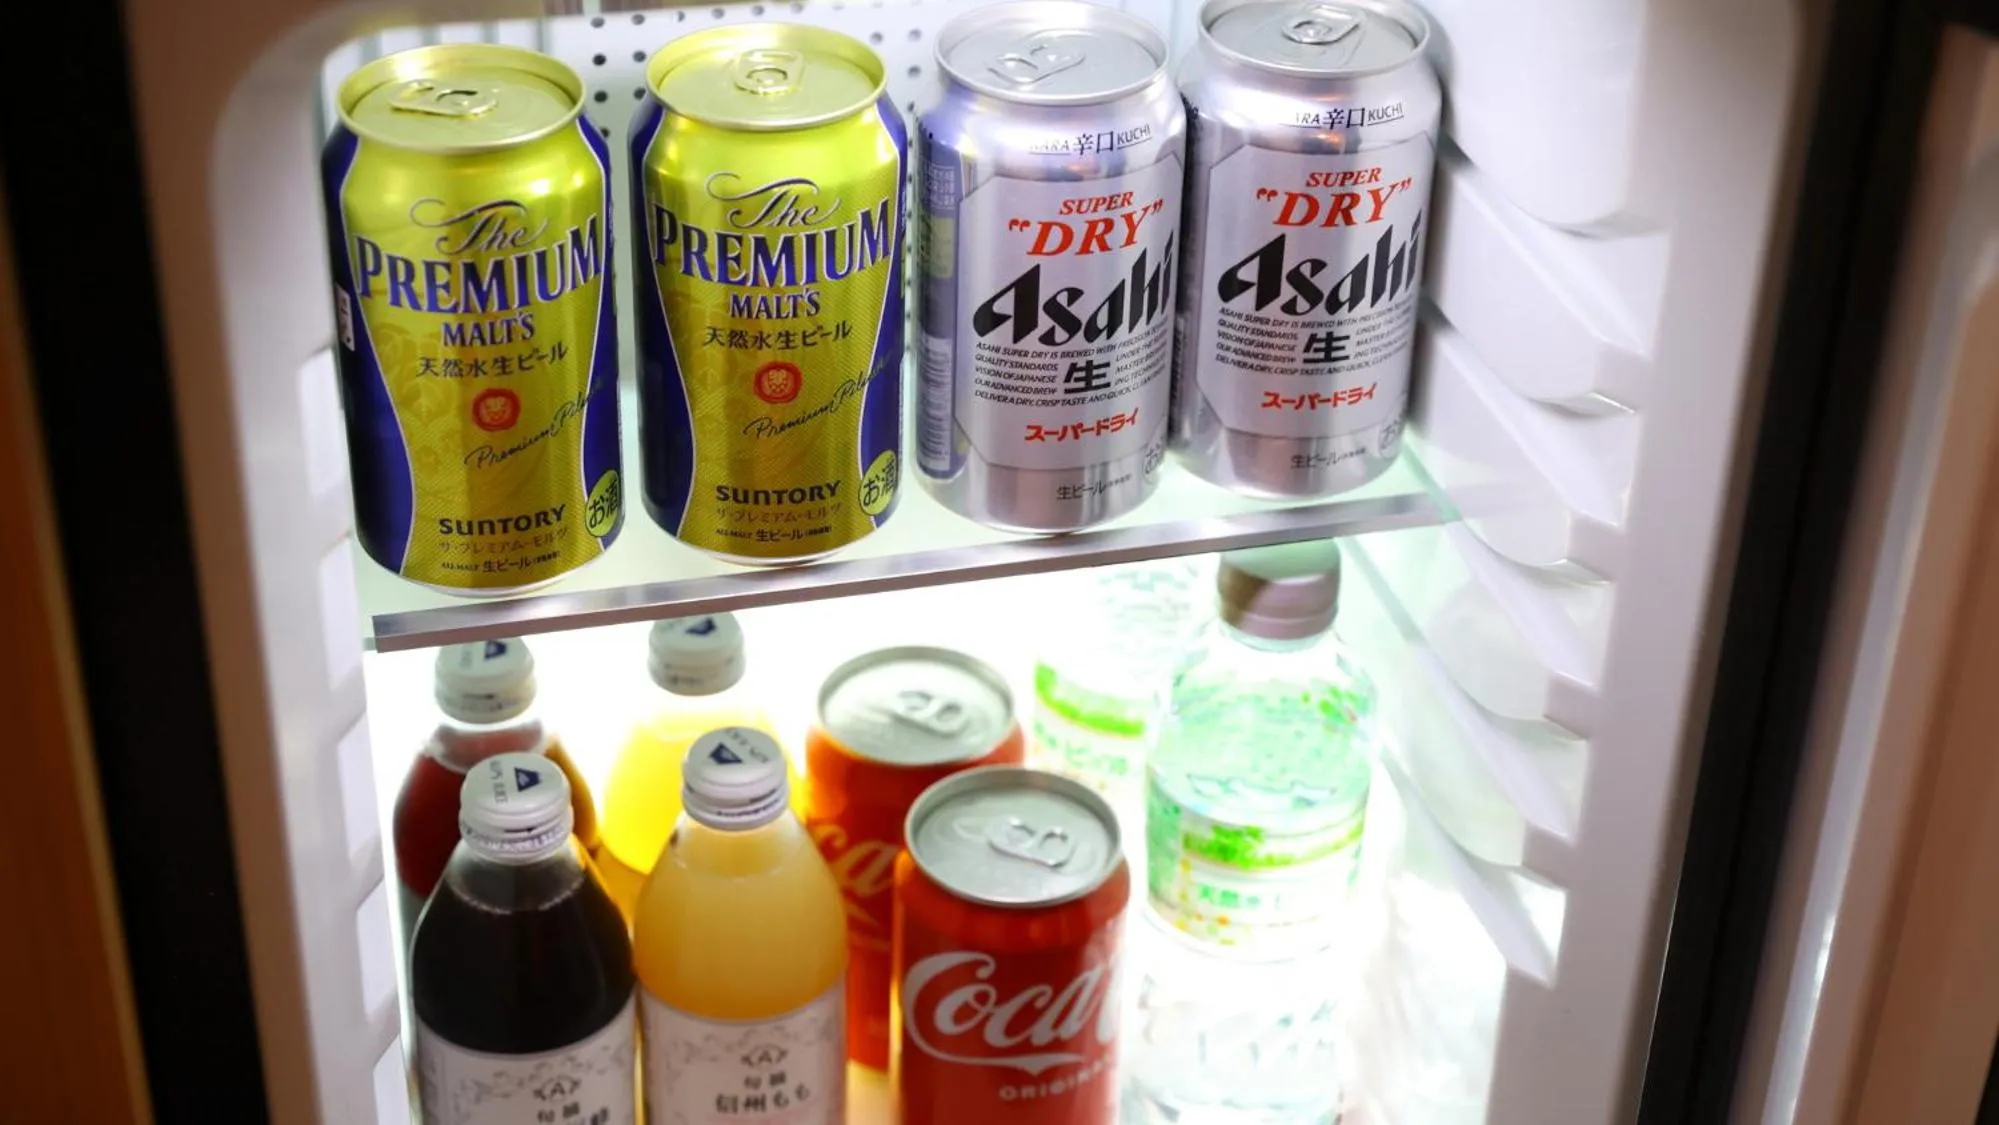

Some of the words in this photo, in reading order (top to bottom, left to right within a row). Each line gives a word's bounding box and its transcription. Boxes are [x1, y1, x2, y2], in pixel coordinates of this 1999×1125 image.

[1323, 107, 1366, 131] 辛口
[1368, 102, 1404, 122] KUCHI
[1073, 130, 1115, 157] 辛口
[1117, 123, 1152, 146] KUCHI
[1306, 167, 1382, 187] SUPER
[704, 170, 841, 229] The
[1059, 191, 1134, 216] SUPER
[410, 197, 549, 256] The
[653, 195, 893, 288] PREMIUM
[354, 212, 602, 314] PREMIUM
[1218, 209, 1422, 316] Asahi
[729, 287, 821, 321] MALT'S
[972, 230, 1175, 347] Asahi
[442, 311, 535, 348] MALT'S
[1217, 317, 1249, 334] QUALITY
[1218, 306, 1244, 320] ASAHI
[1243, 313, 1271, 326] SUPER
[703, 320, 854, 350] 天然水生ビール
[976, 341, 1001, 354] ASAHI
[1002, 346, 1030, 358] SUPER
[1030, 349, 1049, 359] DRY
[1060, 348, 1095, 360] BREWED
[1302, 330, 1350, 364] 生
[415, 341, 569, 378] 天然水生ビール
[975, 353, 1008, 368] QUALITY
[1008, 360, 1059, 372] STANDARDS
[1063, 359, 1112, 394] 生
[974, 389, 1009, 404] DELIVER
[1035, 398, 1061, 408] CRISP
[1062, 396, 1088, 407] TASTE
[1262, 382, 1378, 410] スーパードライ
[742, 398, 835, 438] Premium
[1025, 407, 1140, 443] スーパードライ
[463, 422, 558, 469] Premium
[716, 479, 841, 505] SUNTORY
[1056, 477, 1105, 501] 生ビール
[439, 503, 566, 536] SUNTORY
